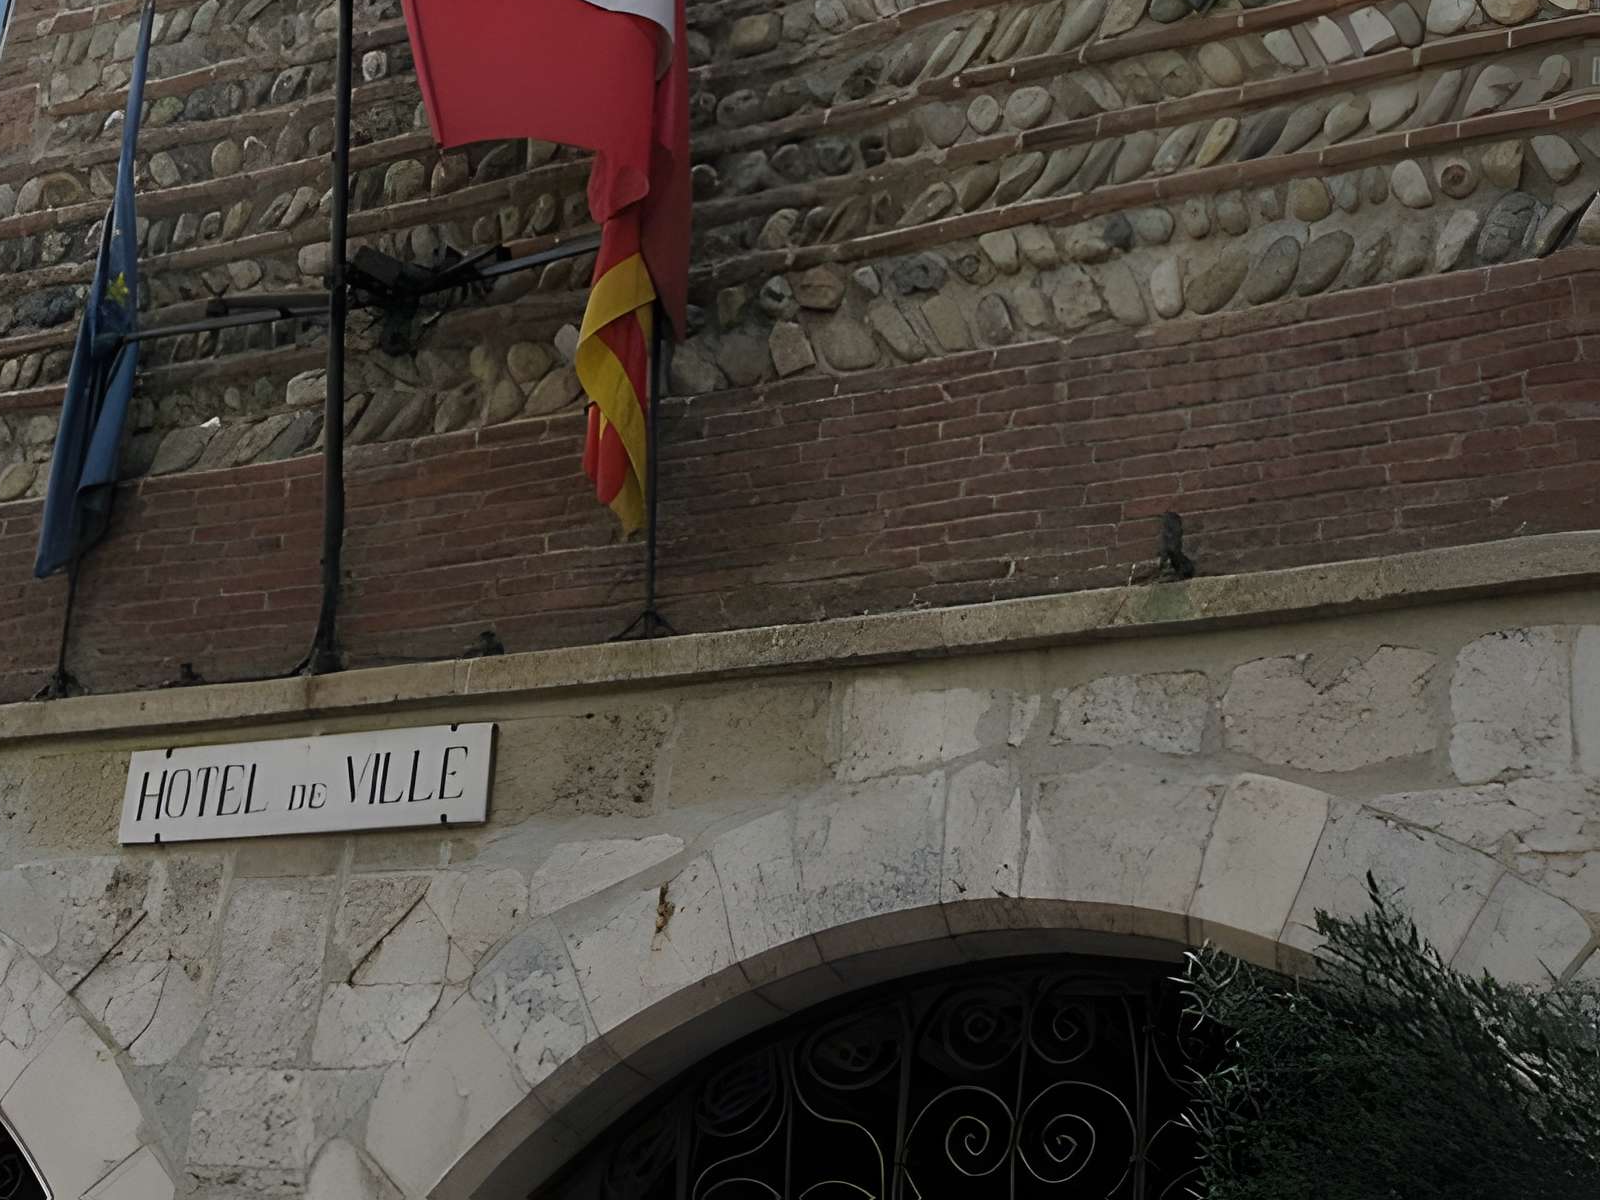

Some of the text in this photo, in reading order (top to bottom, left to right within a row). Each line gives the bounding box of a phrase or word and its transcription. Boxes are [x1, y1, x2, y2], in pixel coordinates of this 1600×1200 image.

[136, 746, 469, 821] HOTEL DE VILLE
